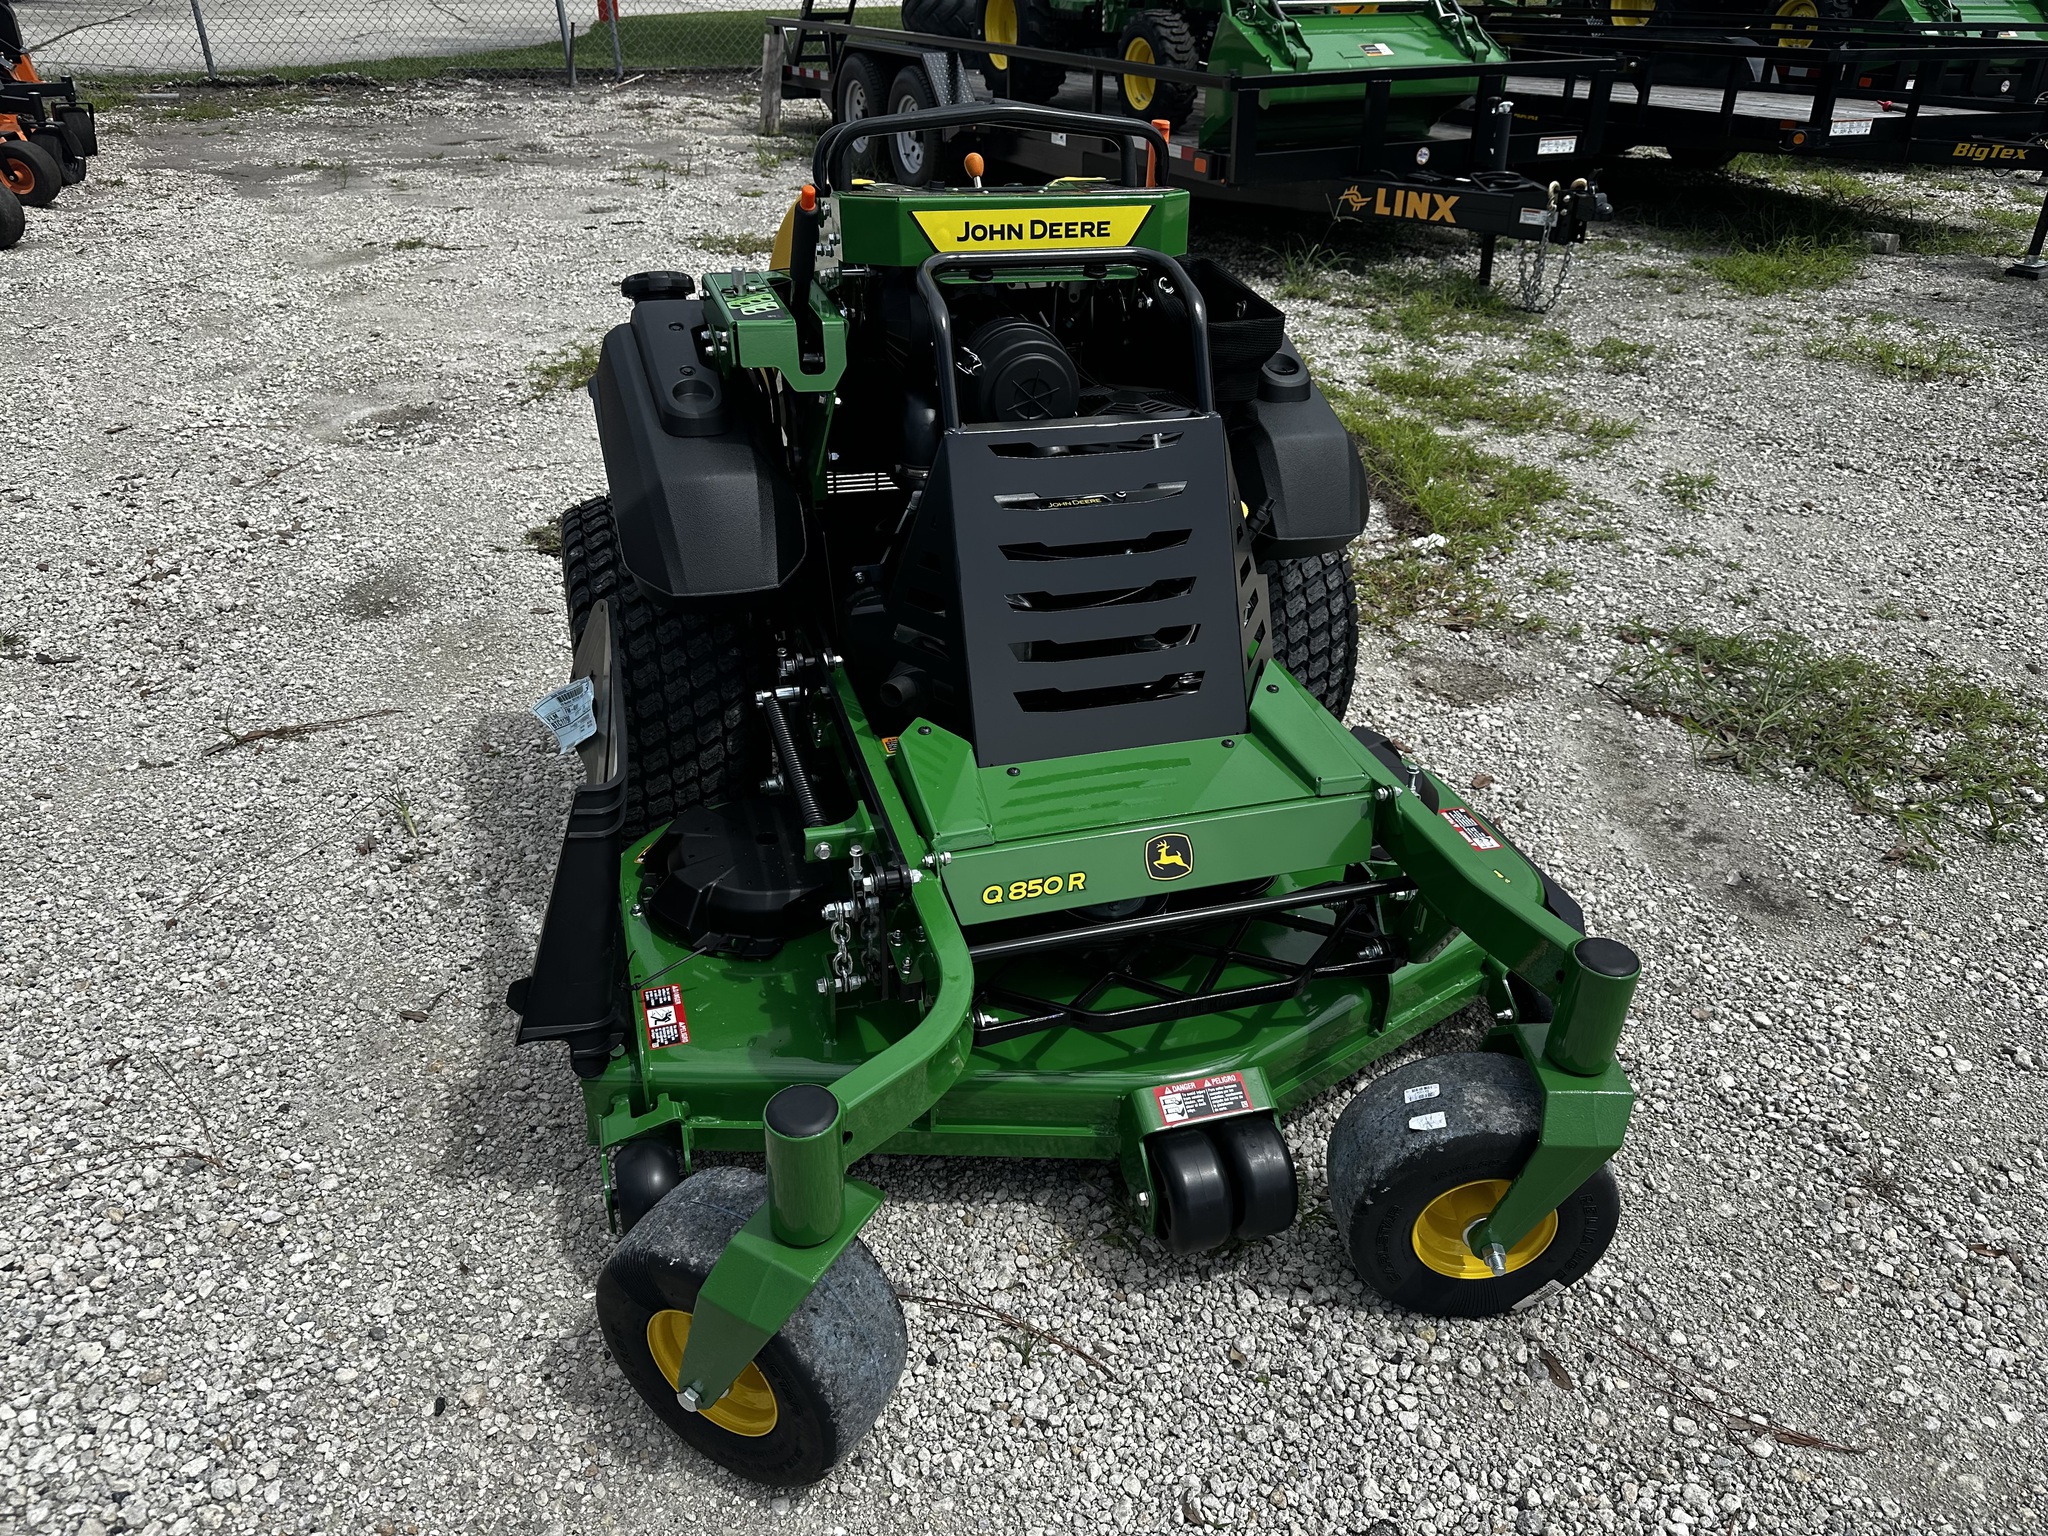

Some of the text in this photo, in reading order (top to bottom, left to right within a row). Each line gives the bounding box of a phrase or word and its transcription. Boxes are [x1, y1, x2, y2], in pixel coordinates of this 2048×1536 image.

[1952, 142, 2029, 161] BigTex
[1375, 187, 1460, 224] LINX
[956, 219, 1111, 242] JOHN DEERE
[1048, 498, 1102, 508] JOHN DEERE
[982, 871, 1087, 905] Q 850 R
[1171, 1074, 1236, 1093] DANGER PELIGRO
